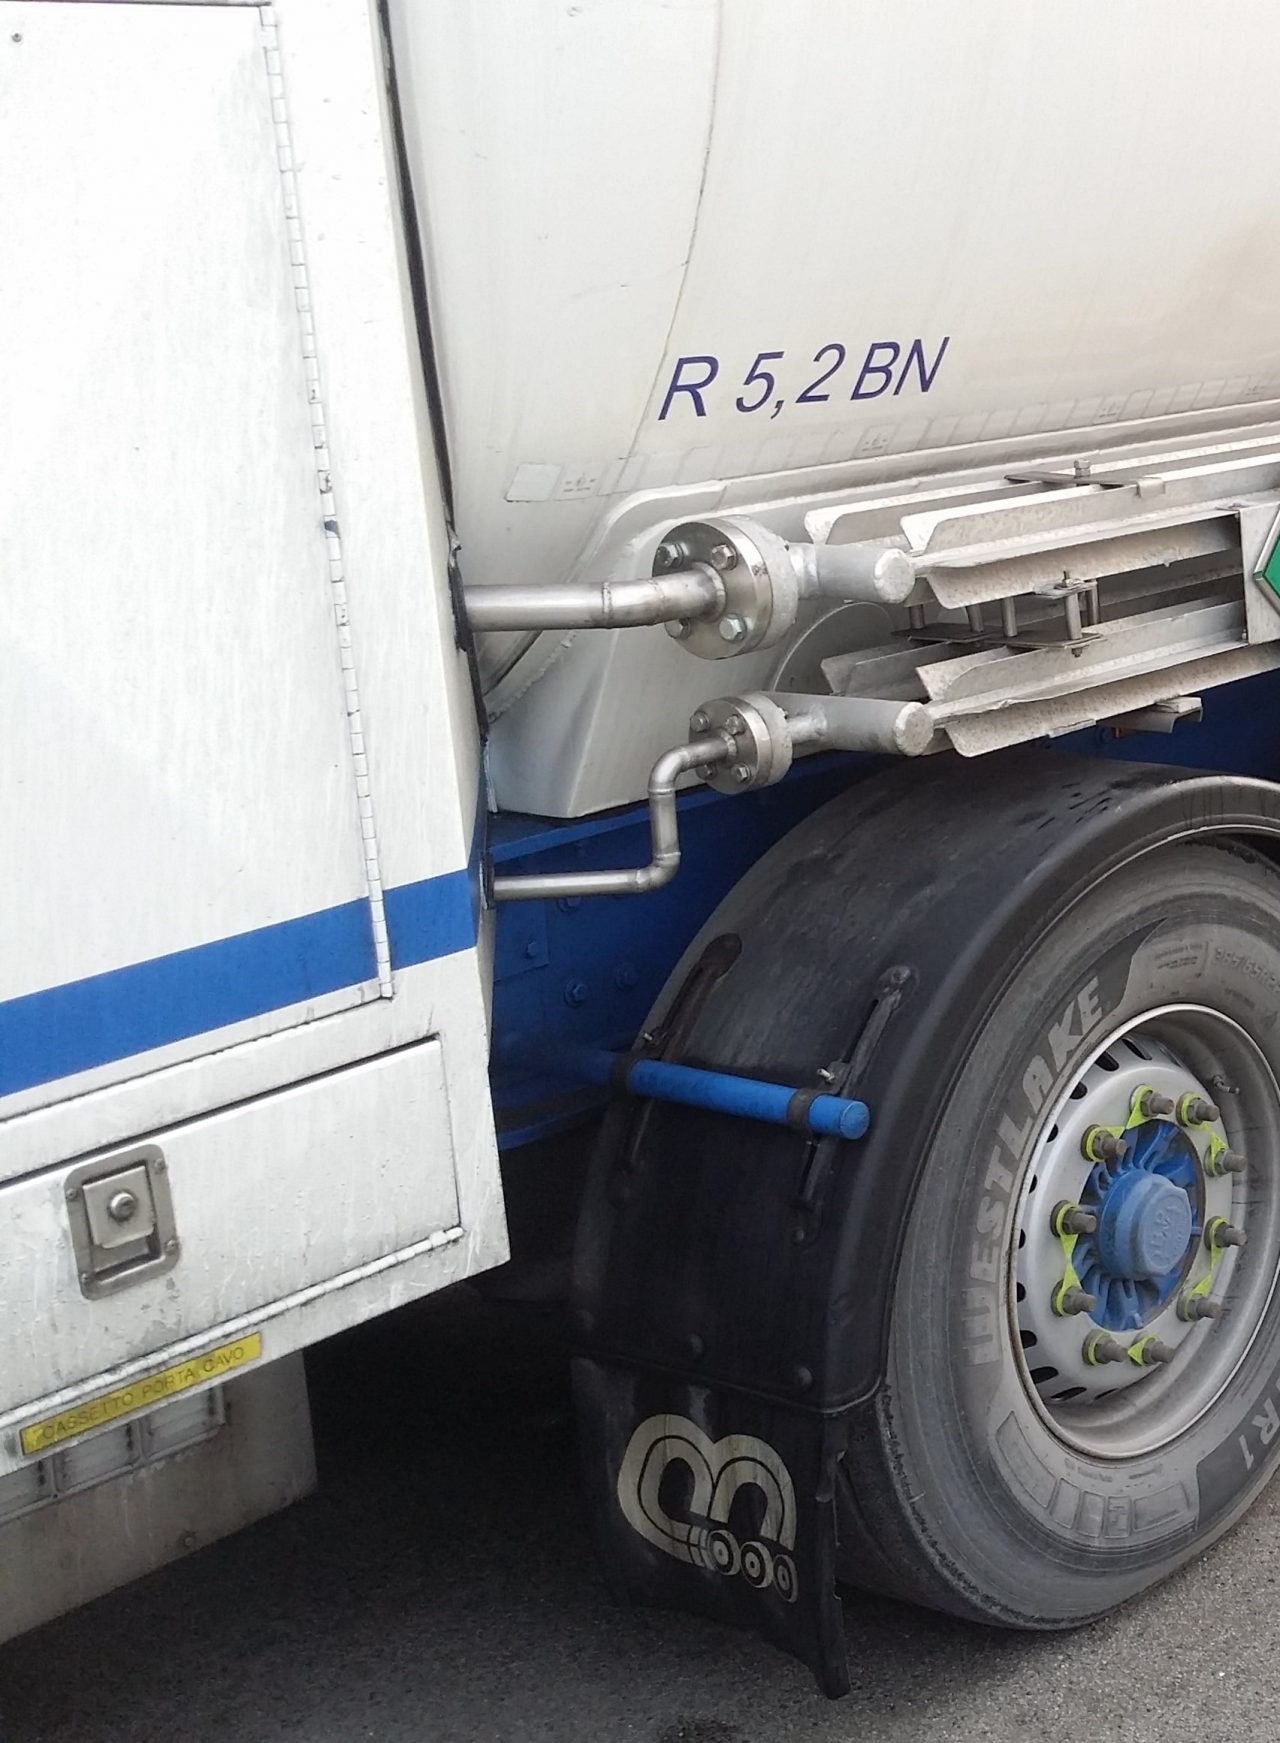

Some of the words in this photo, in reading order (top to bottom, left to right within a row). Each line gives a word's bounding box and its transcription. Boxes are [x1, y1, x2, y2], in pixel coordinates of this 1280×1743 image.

[658, 356, 719, 420] R
[736, 343, 846, 420] 5,2
[850, 336, 950, 401] BN
[963, 976, 1104, 1366] WESTLAKE
[41, 1390, 135, 1442] CASSETTO
[141, 1367, 195, 1400] PORTA
[203, 1346, 244, 1373] CAVO
[1238, 1434, 1255, 1471] 1
